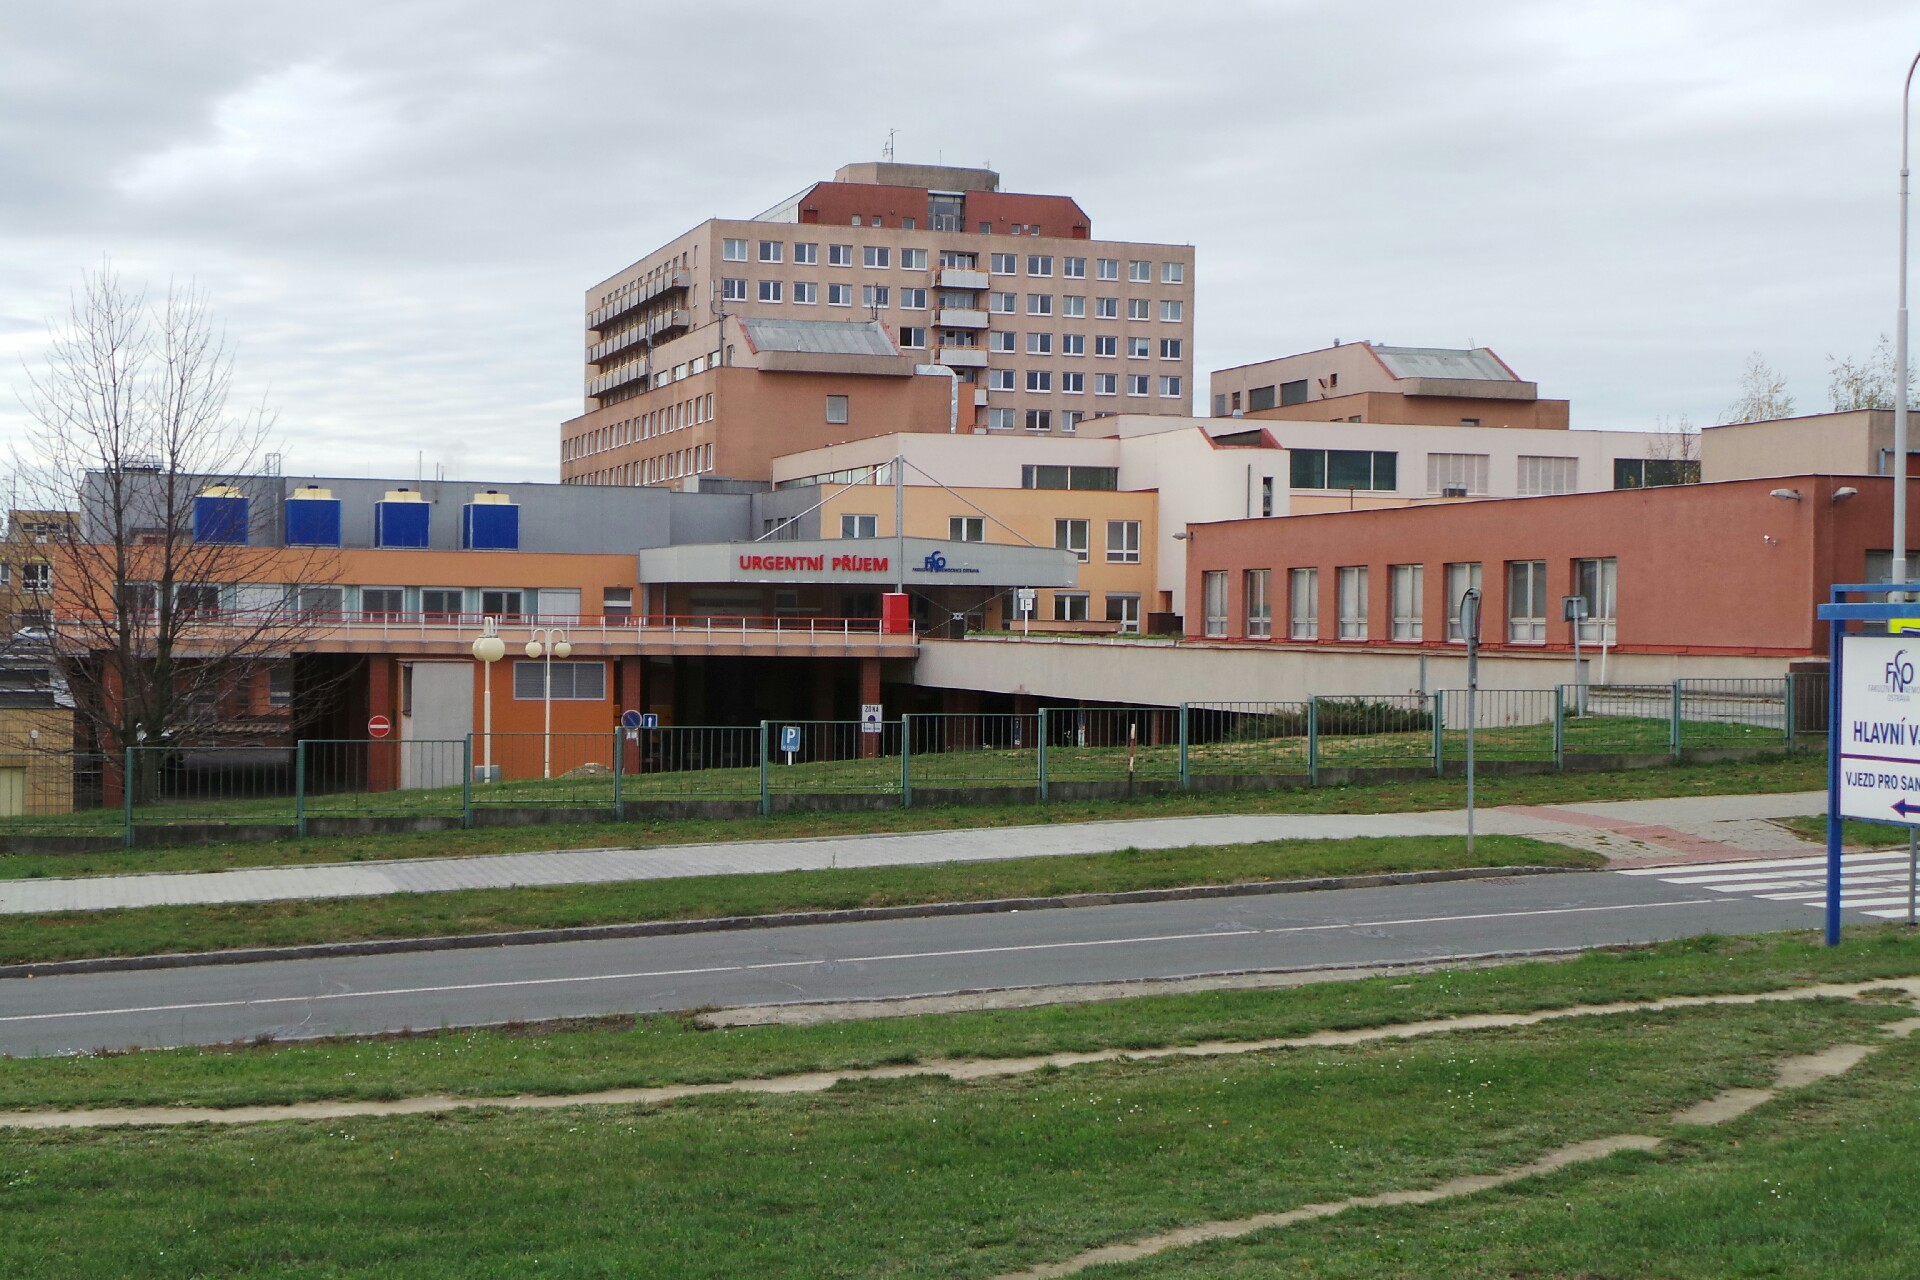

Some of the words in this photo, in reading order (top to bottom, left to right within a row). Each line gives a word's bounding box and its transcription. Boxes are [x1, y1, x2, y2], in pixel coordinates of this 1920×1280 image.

[739, 554, 824, 571] URGENTNÍ
[832, 555, 889, 572] PŘÍJEM
[786, 728, 796, 744] P
[1853, 717, 1906, 746] HLAVNÍ
[1909, 724, 1920, 746] V
[1845, 771, 1876, 788] VJEZD
[1877, 774, 1899, 790] PRO
